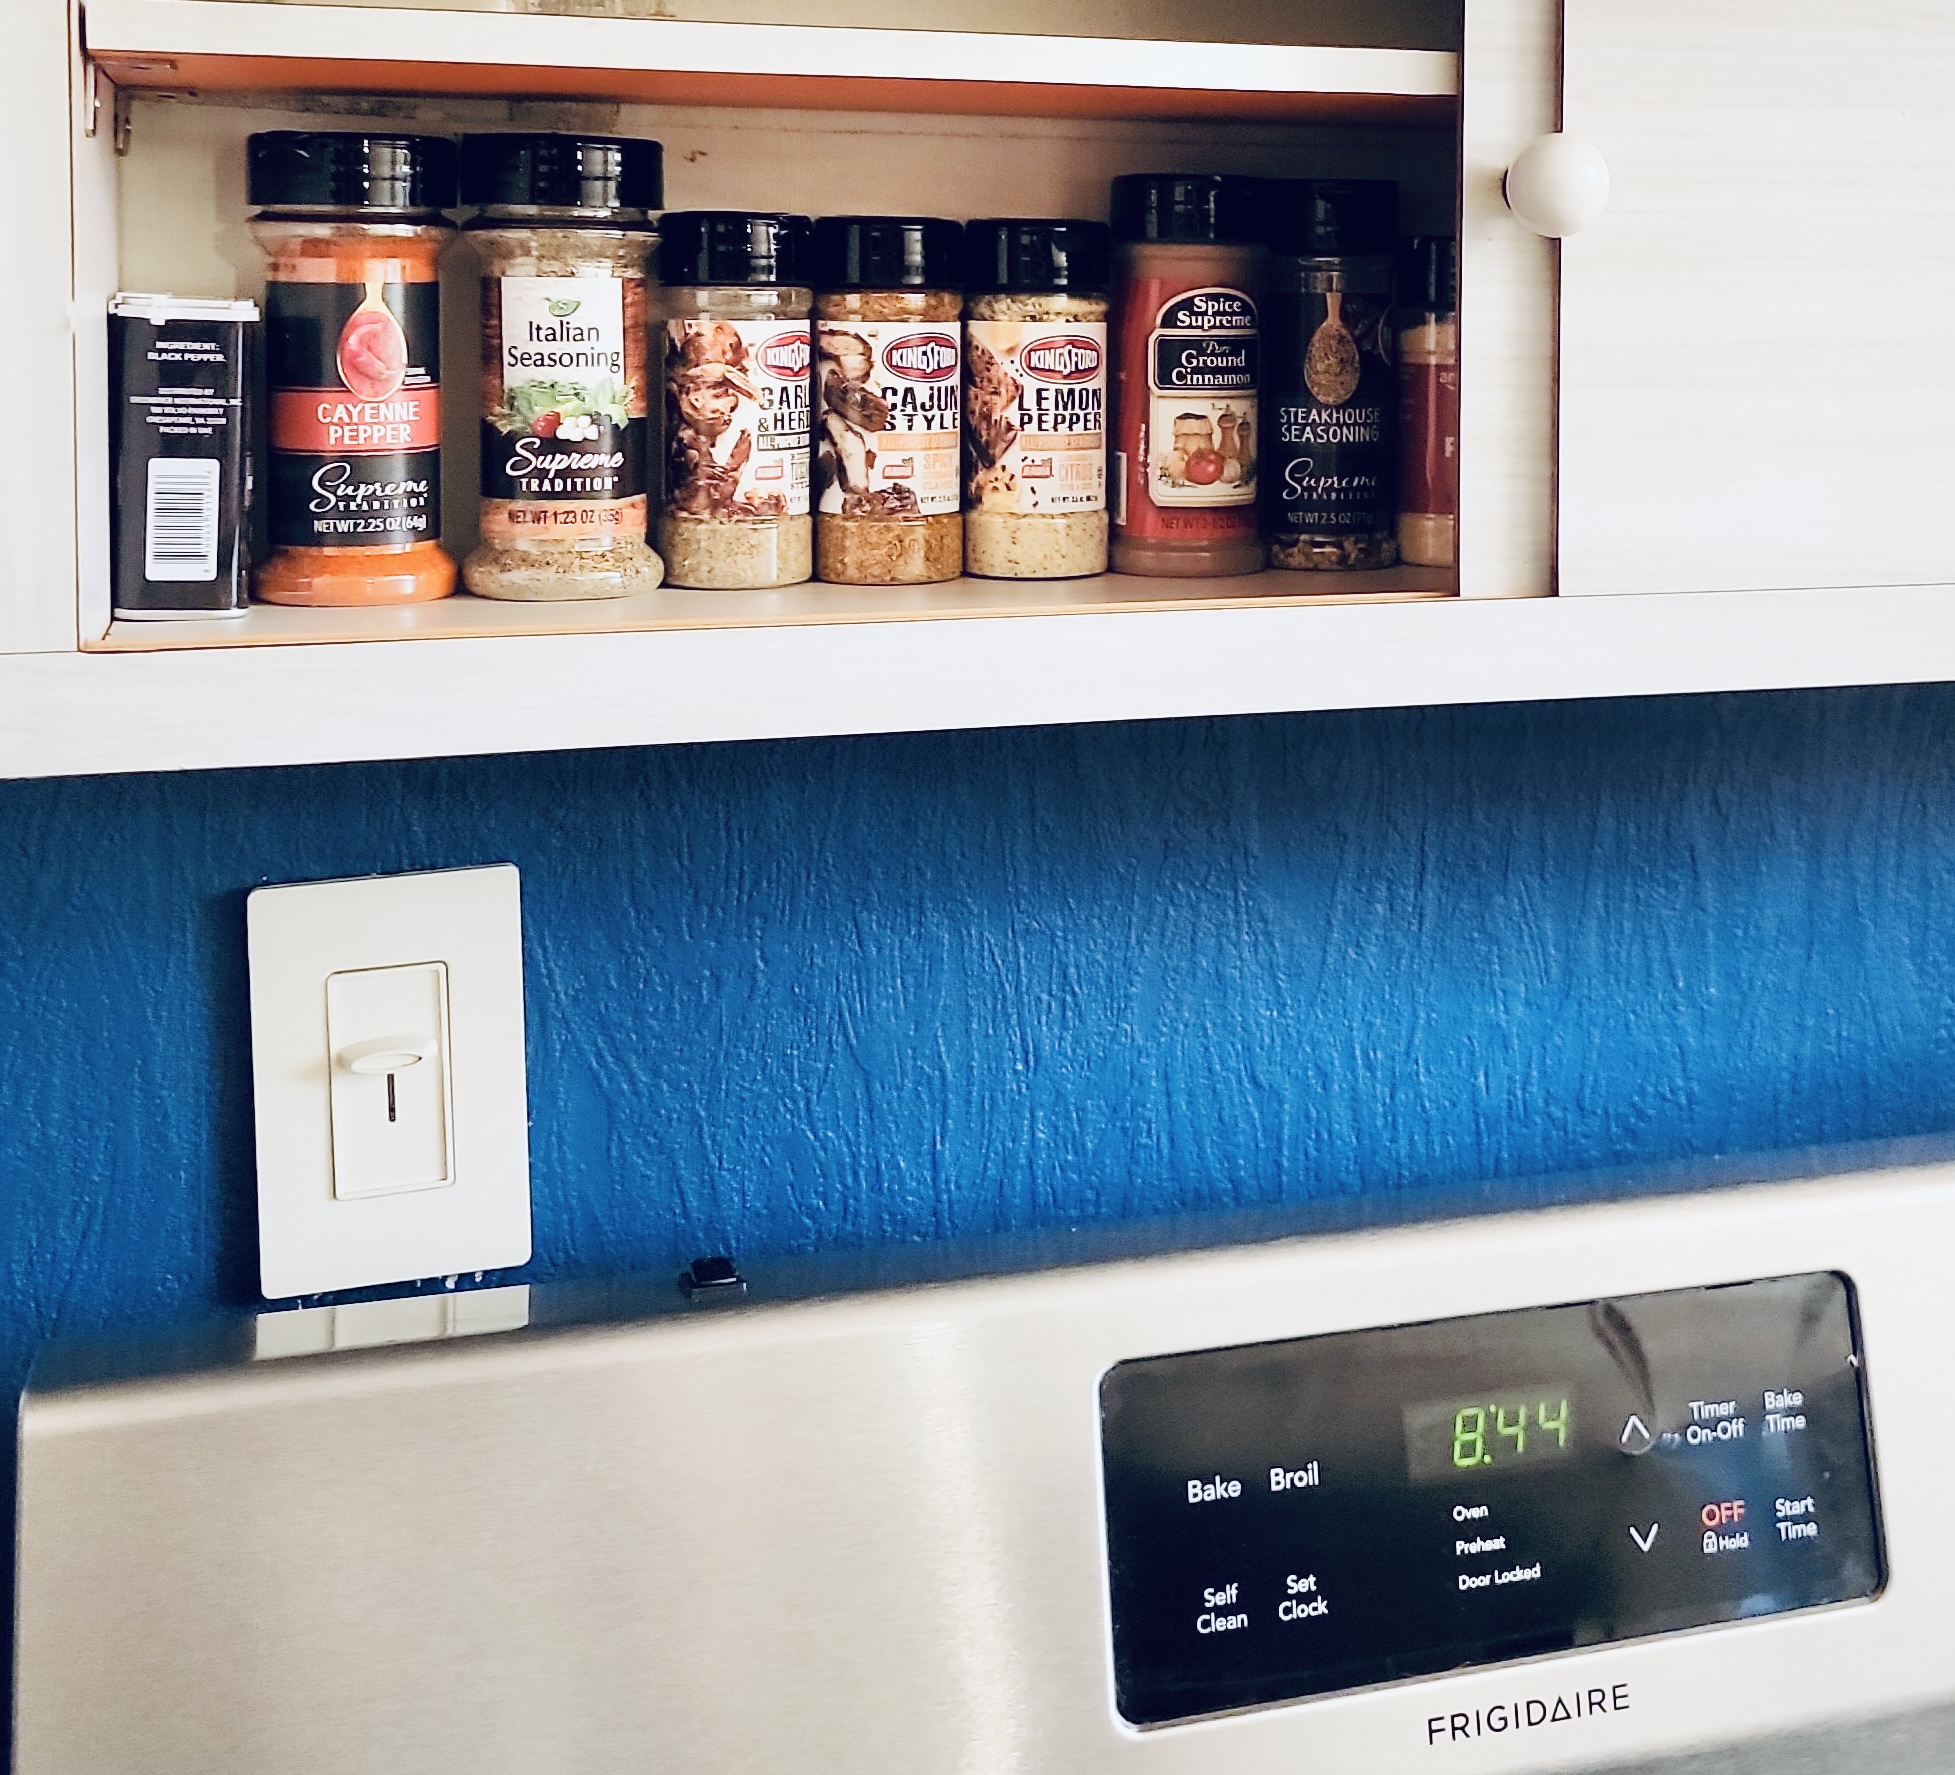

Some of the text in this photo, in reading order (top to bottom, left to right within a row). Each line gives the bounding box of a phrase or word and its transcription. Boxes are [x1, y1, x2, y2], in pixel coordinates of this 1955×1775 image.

[1193, 296, 1242, 316] Spice
[528, 319, 600, 343] Italian
[1176, 310, 1252, 330] Supreme
[147, 351, 183, 361] BLACK
[507, 345, 621, 374] Seasoning
[891, 342, 956, 374] KINGSFORD
[1030, 344, 1099, 376] KINGSFORD
[1181, 348, 1246, 368] Ground
[1171, 367, 1251, 386] Cinnamon
[880, 384, 959, 413] CAJUN
[1017, 387, 1102, 412] LEMON
[317, 400, 421, 424] CAYENNE
[884, 411, 959, 432] STYLE
[1019, 411, 1102, 432] PEPPER
[1279, 407, 1381, 425] STEAKHOUSE
[328, 423, 413, 446] PEPPER
[757, 417, 769, 432] &
[1281, 424, 1380, 444] SEASONING
[505, 436, 625, 479] Supreme
[308, 461, 429, 513] Supreme
[1282, 457, 1377, 501] Supreme
[313, 519, 334, 534] NET
[334, 519, 355, 533] WT
[356, 518, 385, 532] 2.25
[385, 516, 402, 531] OZ
[508, 509, 530, 525] NET
[530, 509, 549, 525] WT
[551, 510, 578, 525] 1.23
[580, 509, 596, 524] OZ
[1161, 516, 1180, 530] NET
[1183, 516, 1200, 530] WT
[1287, 512, 1303, 524] NET
[1304, 512, 1319, 524] WT
[1320, 512, 1337, 525] 2.5
[1338, 512, 1351, 524] OZ
[1763, 1387, 1804, 1411] Bake
[1688, 1400, 1737, 1422] Timer
[1453, 1398, 1568, 1468] 8:44
[1686, 1418, 1746, 1446] On-Off
[1765, 1413, 1807, 1434] Time
[1269, 1460, 1320, 1492] Broil
[1187, 1474, 1242, 1504] Bake
[1452, 1505, 1489, 1522] Oven
[1701, 1499, 1746, 1528] OFF
[1774, 1495, 1816, 1518] Start
[1718, 1532, 1750, 1552] Hold
[1775, 1520, 1819, 1542] Time
[1455, 1535, 1507, 1556] Preheat
[1286, 1573, 1318, 1595] Set
[1458, 1561, 1542, 1591] Door Locked
[1203, 1582, 1239, 1608] Self
[1278, 1595, 1329, 1622] Clock
[1196, 1612, 1249, 1634] Clean
[1427, 1683, 1630, 1746] FRIGIDAIRE
